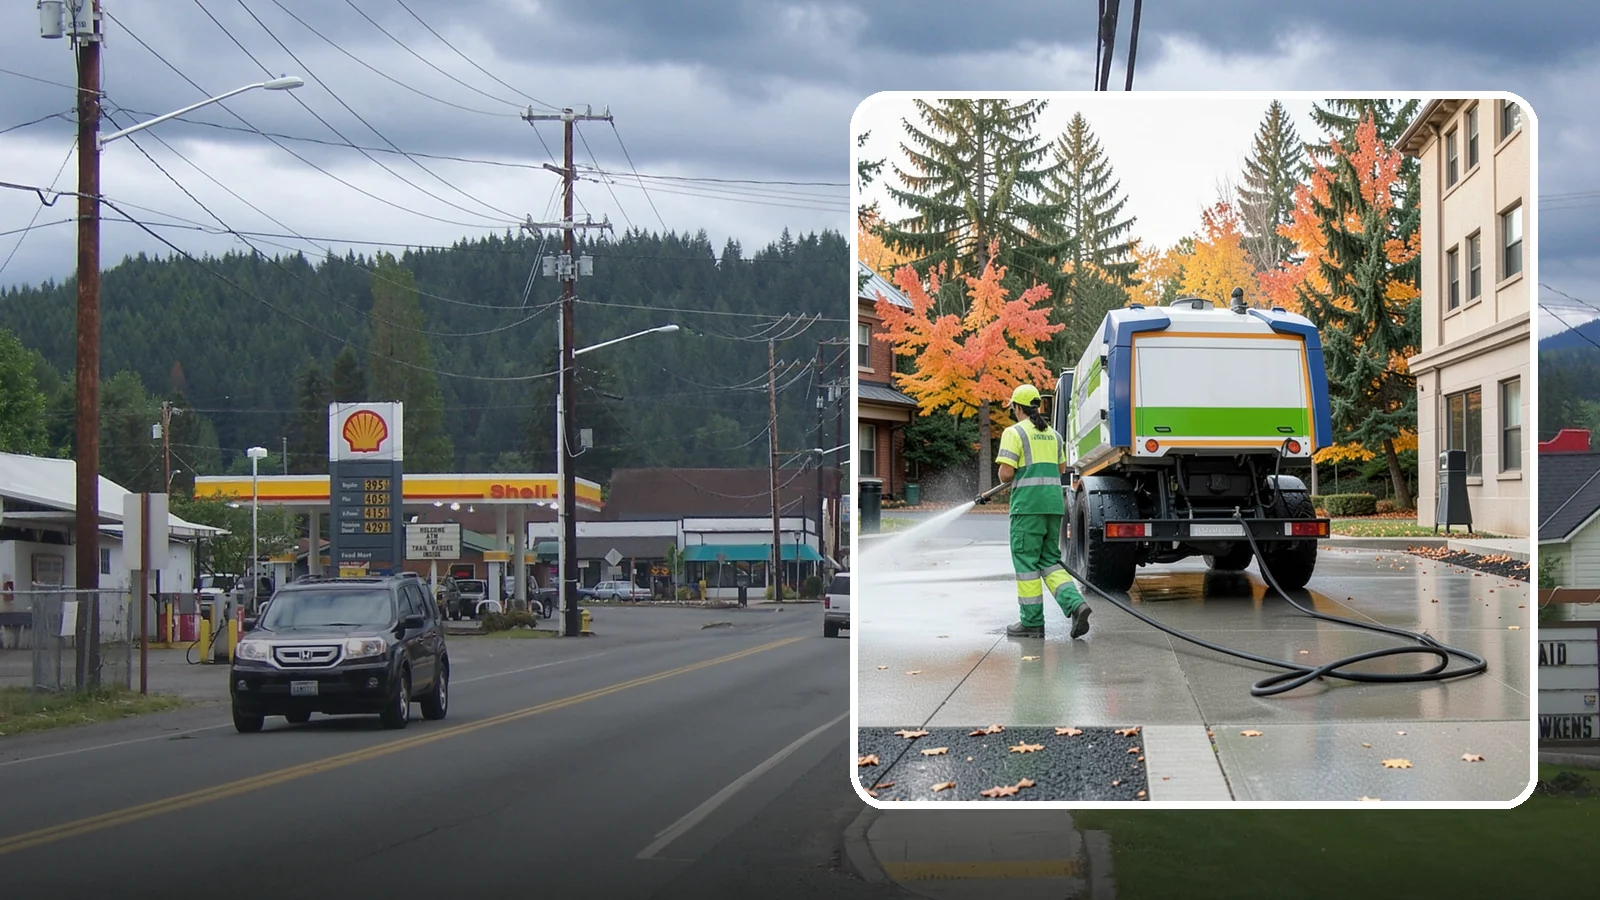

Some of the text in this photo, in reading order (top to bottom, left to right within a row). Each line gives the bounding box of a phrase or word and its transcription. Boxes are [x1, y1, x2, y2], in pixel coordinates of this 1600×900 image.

[365, 480, 383, 490] 395
[490, 484, 547, 499] Shell
[365, 494, 383, 504] 405
[365, 508, 383, 518] 415
[365, 522, 383, 532] 429
